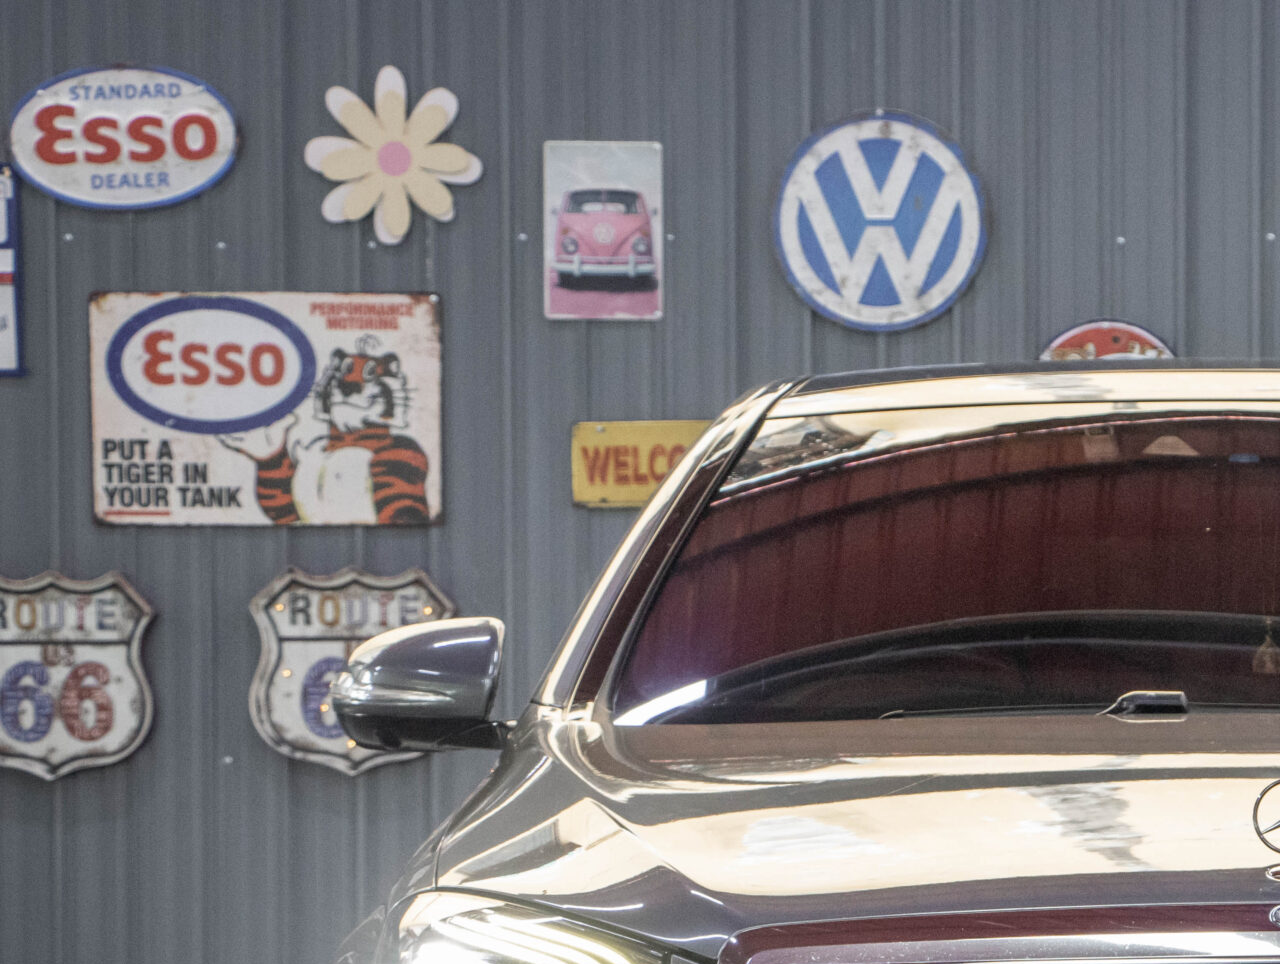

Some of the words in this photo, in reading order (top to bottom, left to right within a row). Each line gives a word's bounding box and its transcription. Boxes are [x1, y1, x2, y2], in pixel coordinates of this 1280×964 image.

[69, 83, 182, 100] STANDARD
[91, 172, 170, 190] DEALER
[326, 317, 400, 331] MOTORING
[102, 439, 149, 461] PUT
[156, 439, 174, 461] A
[102, 463, 174, 484] TIGER
[184, 463, 208, 484] IN
[102, 486, 170, 507] YOUR
[177, 487, 242, 509] TANK
[289, 592, 419, 628] ROUTE
[0, 660, 114, 742] 66
